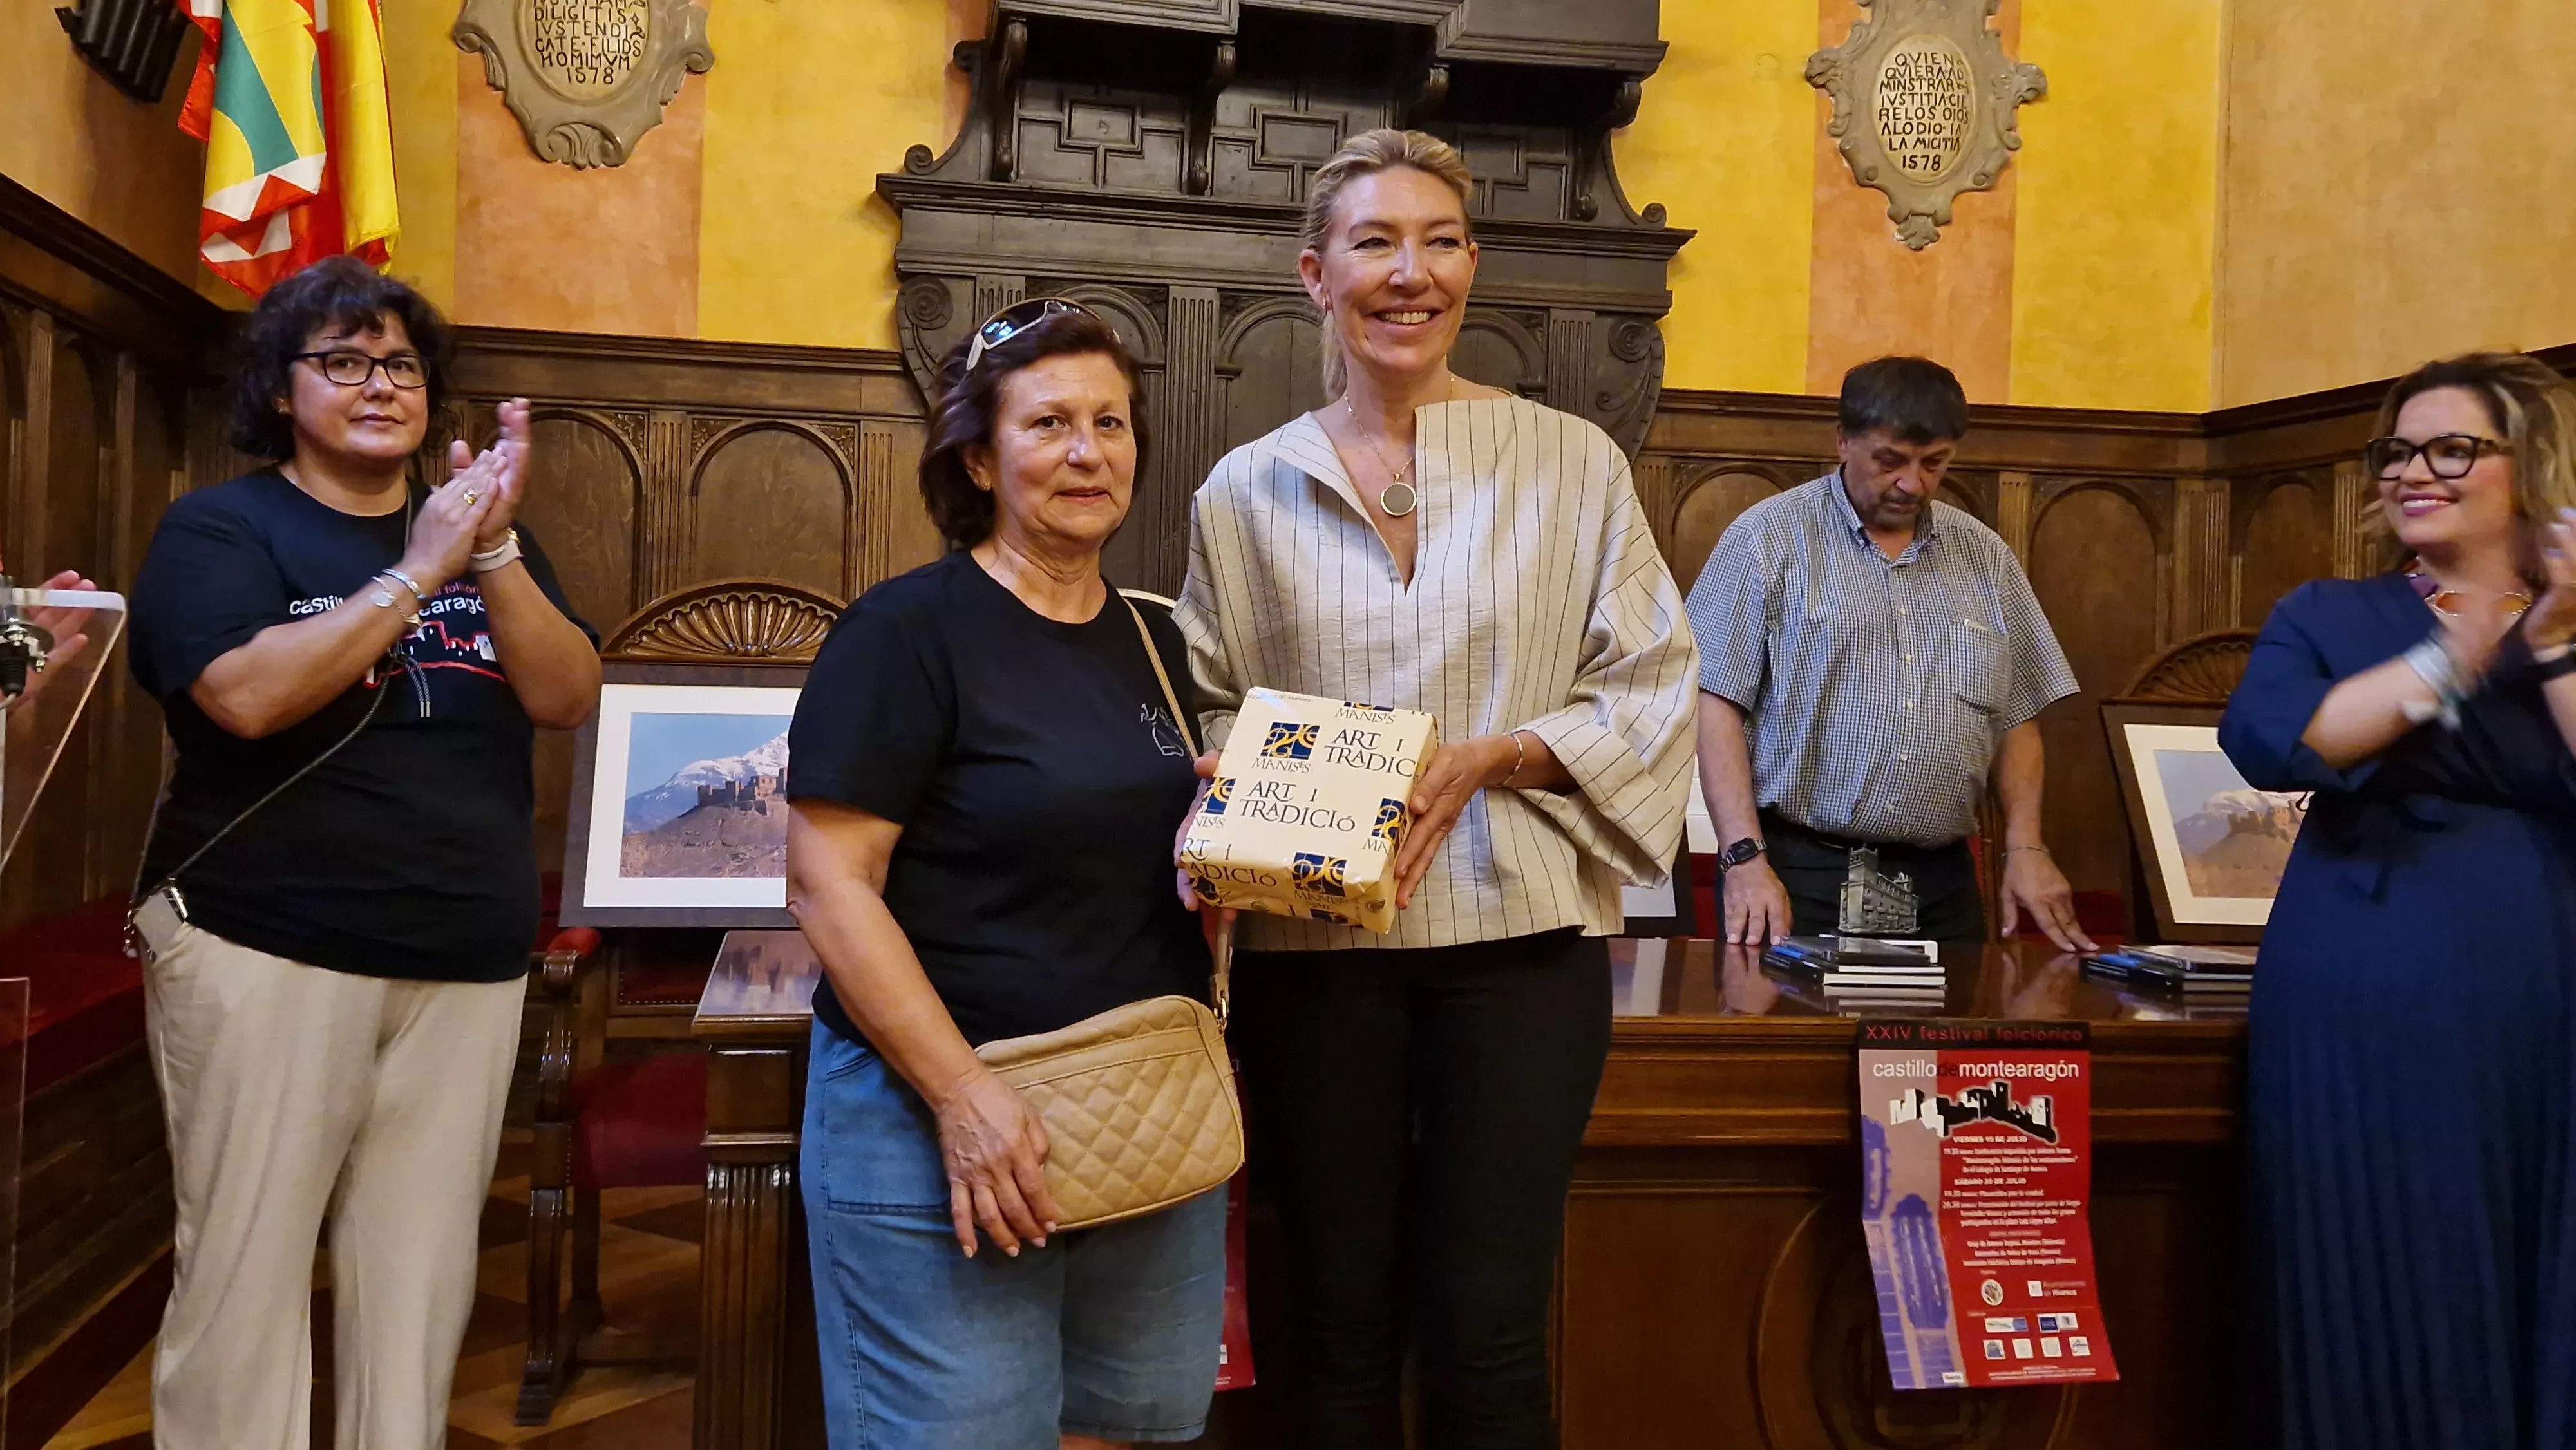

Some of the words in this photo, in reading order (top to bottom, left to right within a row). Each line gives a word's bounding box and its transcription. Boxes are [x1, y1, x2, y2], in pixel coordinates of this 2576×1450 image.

[567, 66, 614, 84] 1578
[1889, 137, 1908, 151] LA
[1902, 154, 1941, 171] 1578
[1334, 708, 1396, 724] MANISES
[1331, 729, 1381, 750] ART
[1396, 739, 1404, 752] I
[1251, 758, 1312, 773] MANISES
[1324, 745, 1416, 777] TRADIC
[1246, 780, 1296, 802] ART
[1310, 789, 1318, 802] I
[1866, 1026, 1911, 1040] XXIV
[1920, 1026, 1988, 1041] festival
